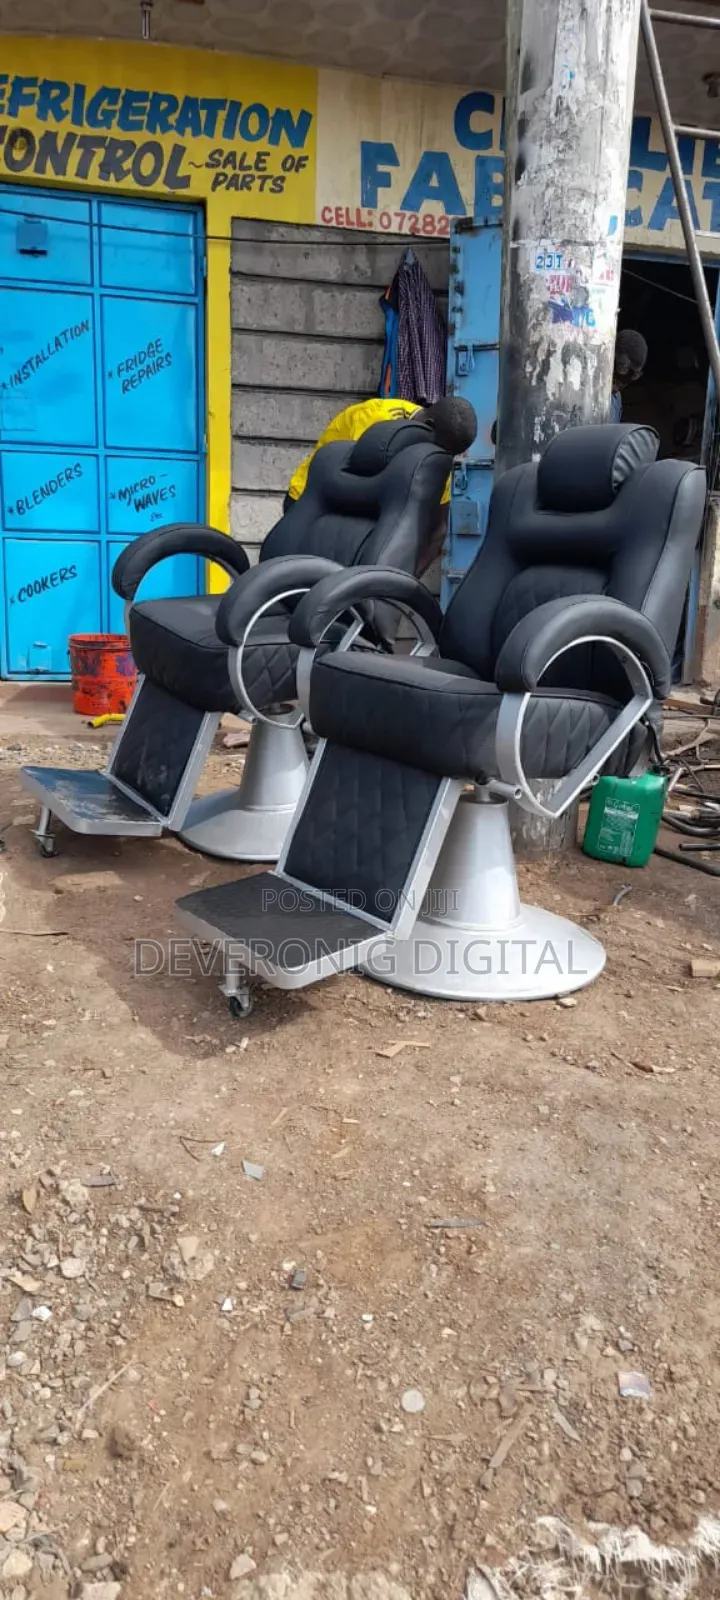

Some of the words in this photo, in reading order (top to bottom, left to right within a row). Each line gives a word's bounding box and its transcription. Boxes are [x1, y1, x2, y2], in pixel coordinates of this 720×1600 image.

[0, 124, 191, 190] ONTROL
[281, 154, 309, 172] OF
[211, 172, 286, 193] PARTS
[321, 206, 373, 228] CELL:
[379, 211, 450, 235] 07282
[9, 320, 90, 388] INSTALLATION
[116, 338, 164, 378] FRIDGE
[121, 352, 173, 395] REPAIRS
[16, 463, 83, 516] BLENDERS
[133, 484, 176, 513] WAVES
[18, 565, 77, 604] COOKERS
